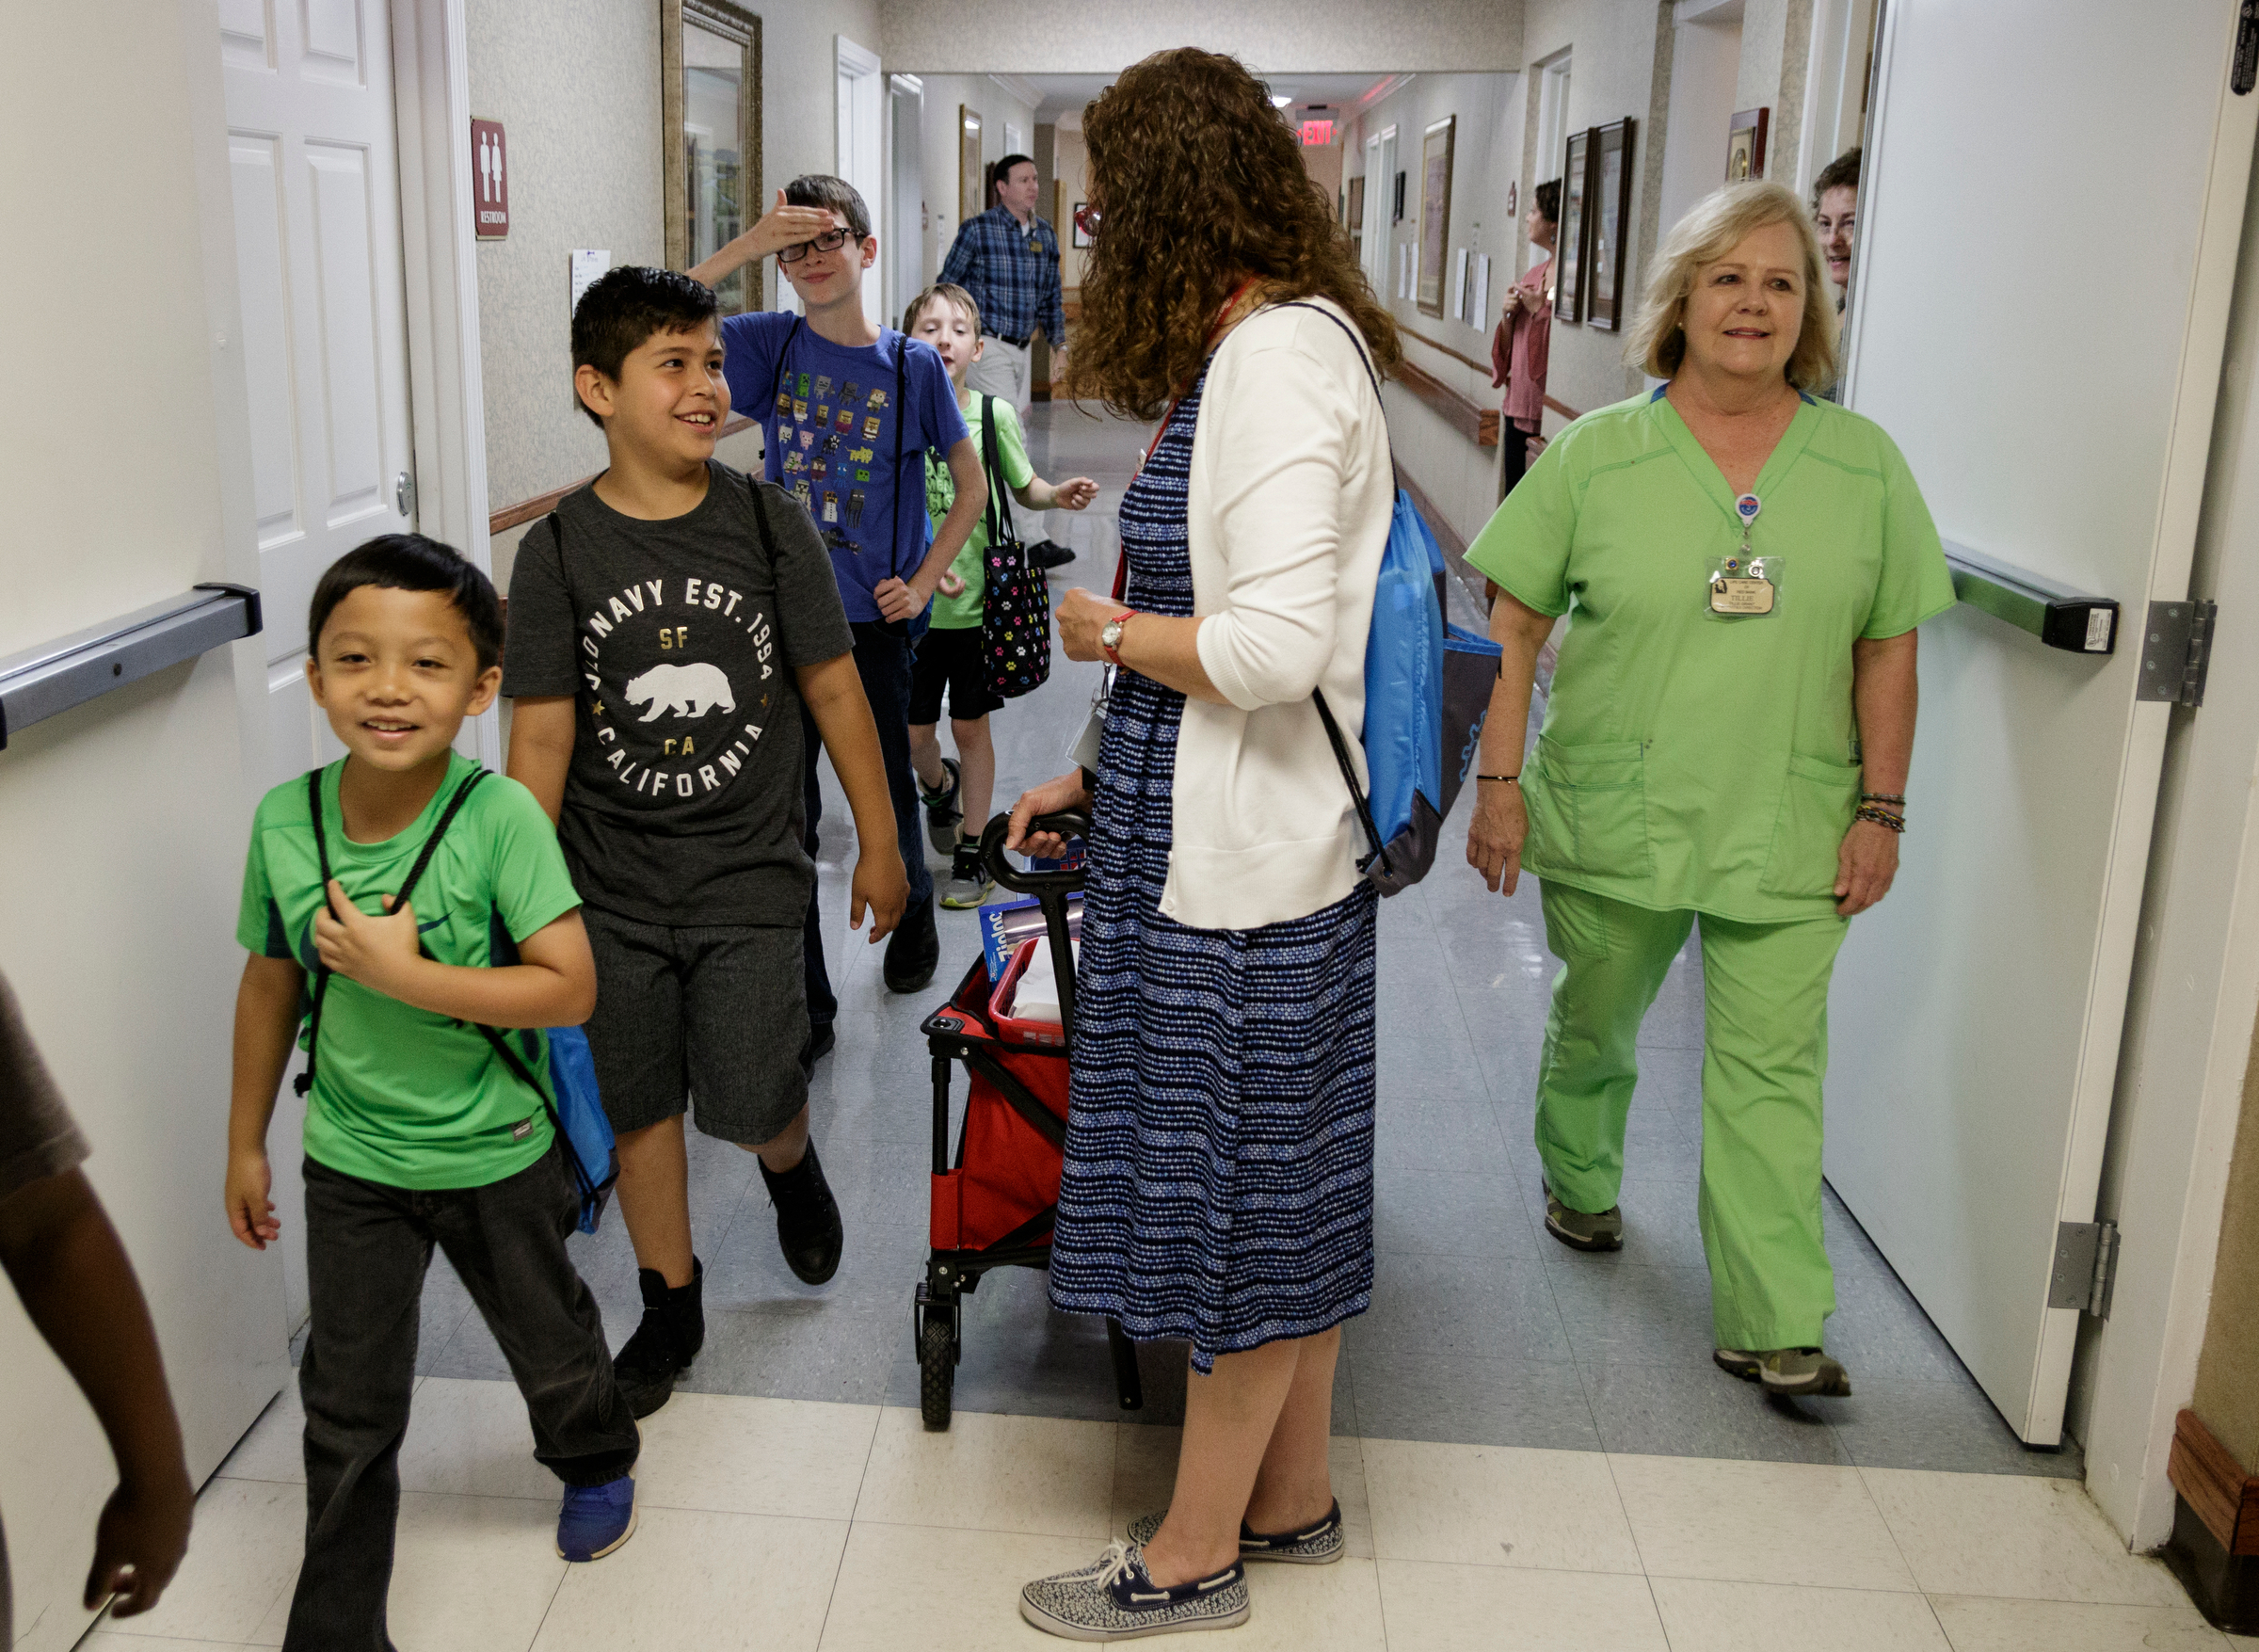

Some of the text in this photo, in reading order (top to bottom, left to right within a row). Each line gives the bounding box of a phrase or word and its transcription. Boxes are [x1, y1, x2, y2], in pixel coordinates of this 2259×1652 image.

[1303, 120, 1333, 146] EXIT
[480, 211, 506, 224] RESTROOM
[589, 579, 663, 638] NAVY
[685, 577, 743, 623] EST.
[746, 612, 773, 680] 1994
[659, 626, 688, 650] SF
[665, 736, 695, 755] CA
[598, 723, 763, 797] CALIFORNIA
